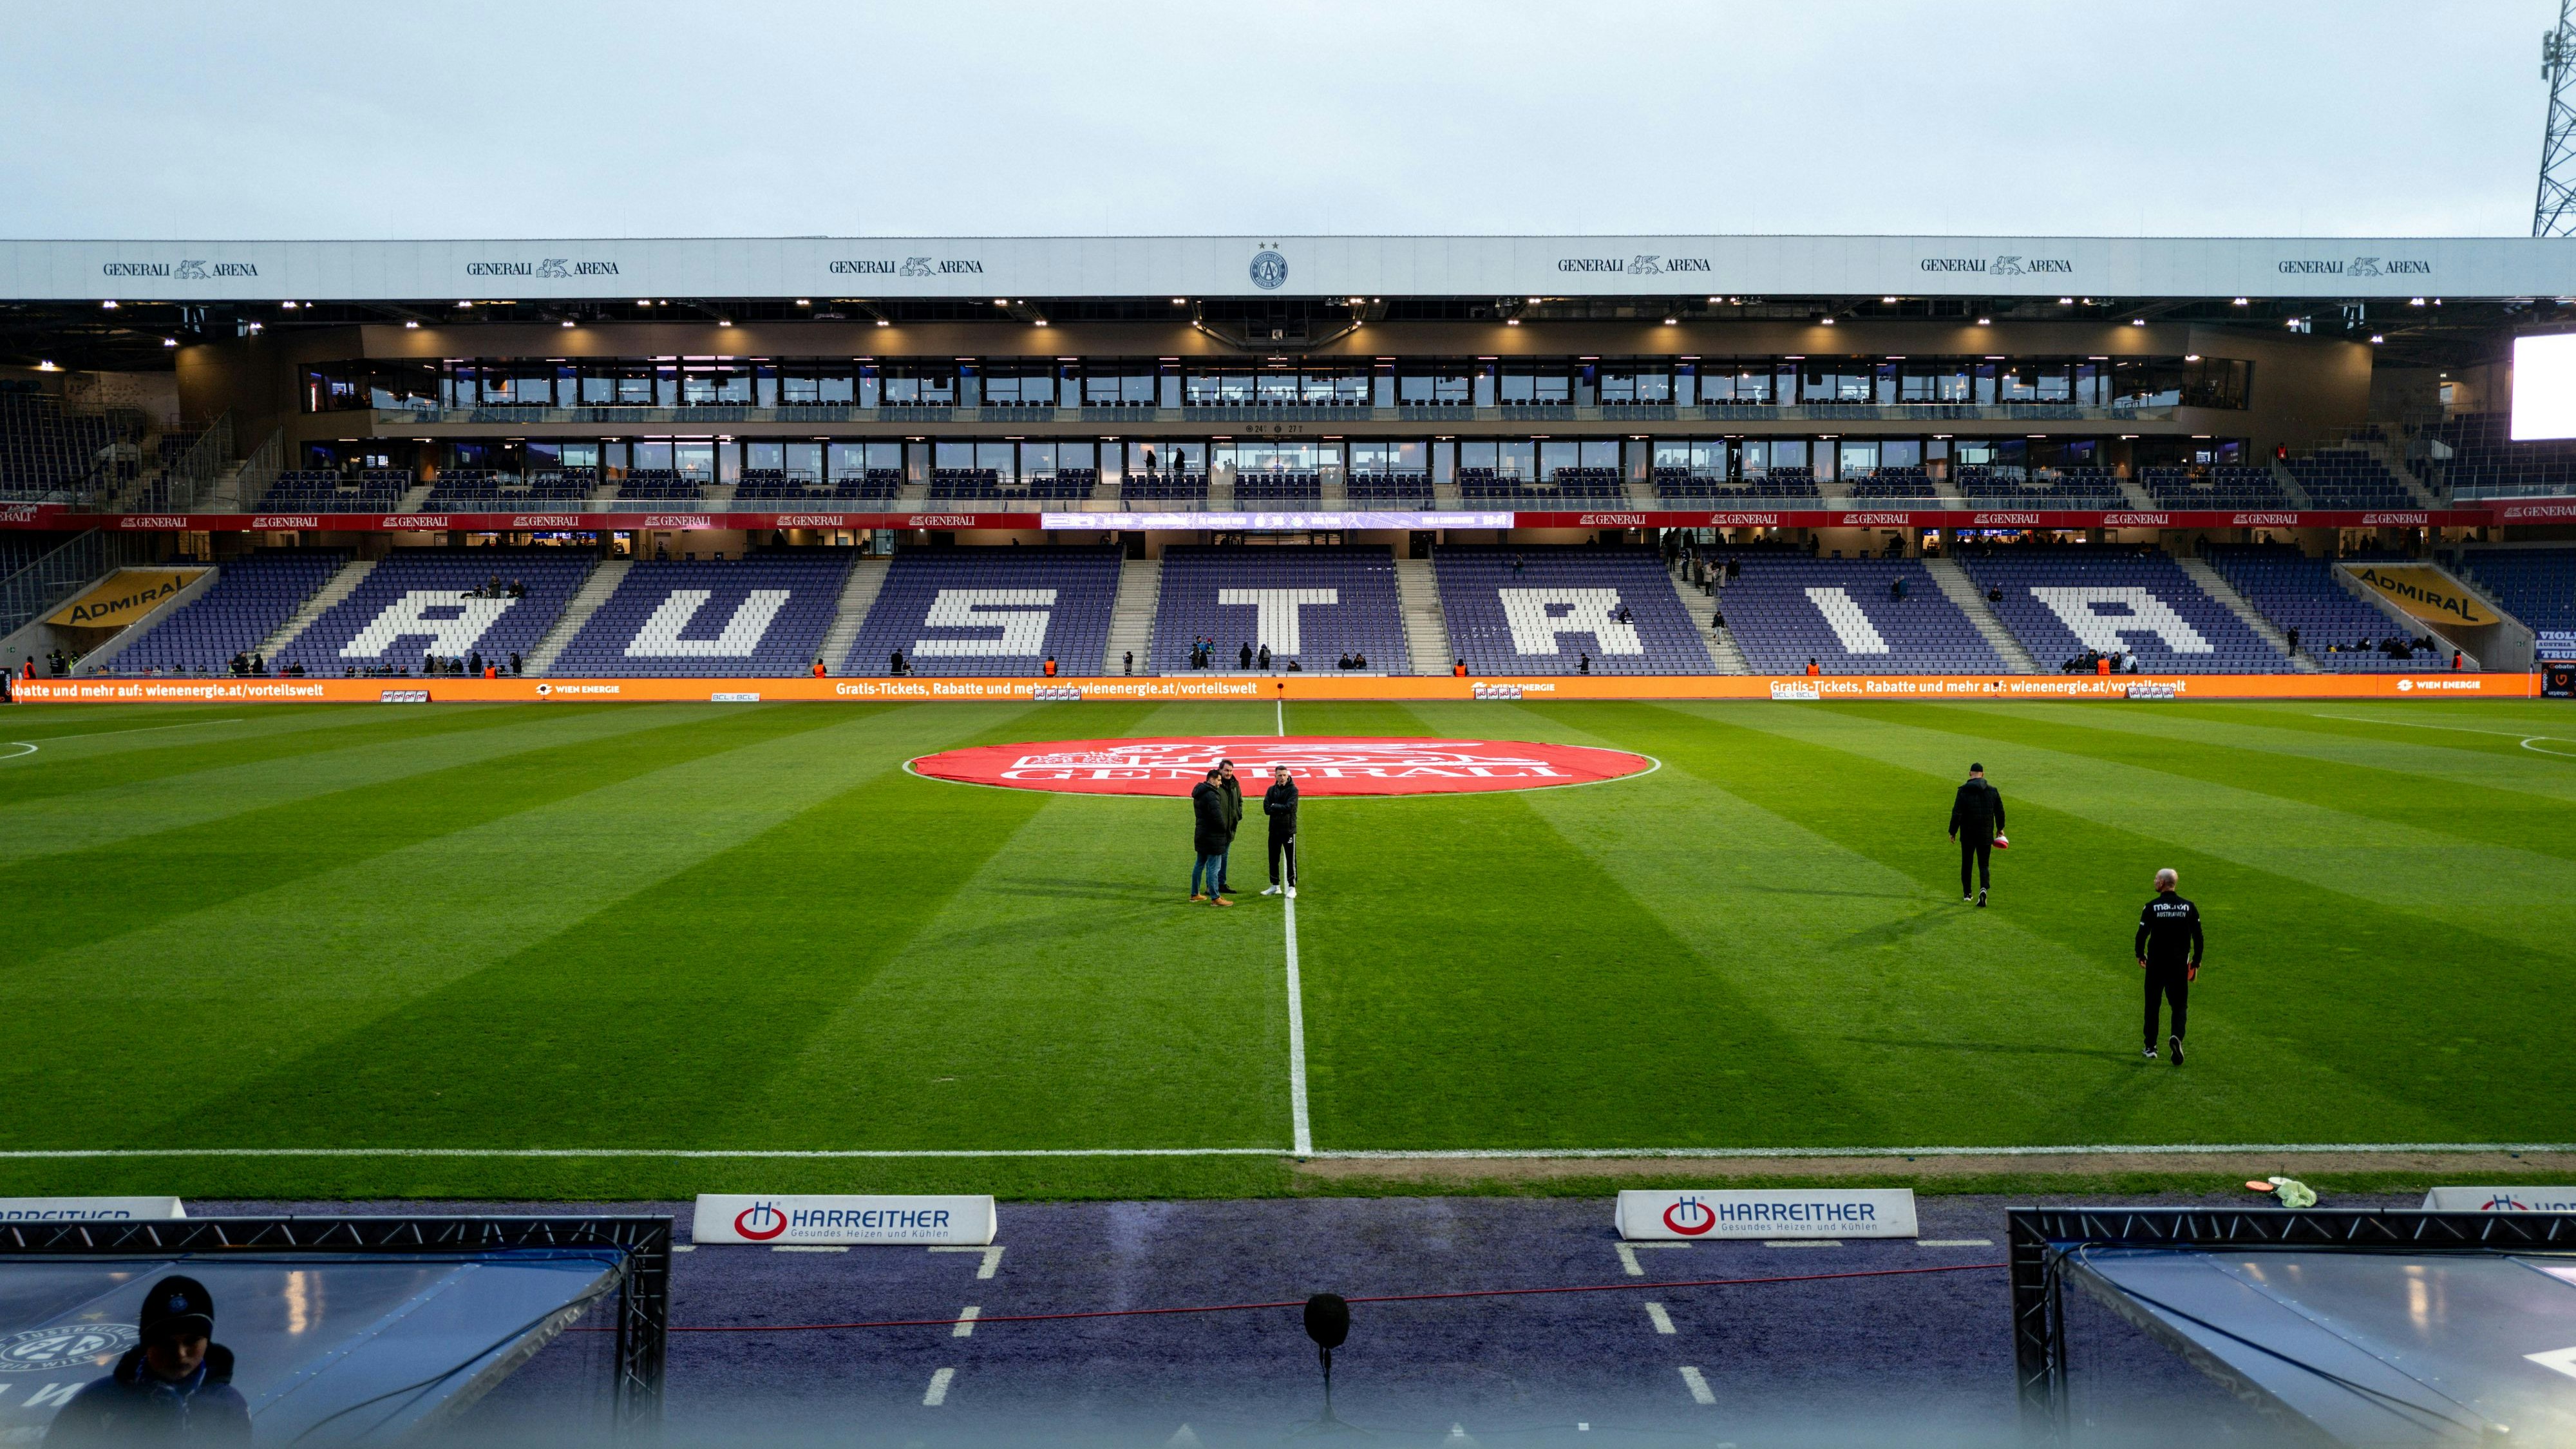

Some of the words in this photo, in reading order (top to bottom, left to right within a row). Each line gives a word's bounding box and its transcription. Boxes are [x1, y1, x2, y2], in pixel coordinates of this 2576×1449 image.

[104, 264, 169, 276] GENERALI
[213, 264, 257, 276] ARENA
[468, 263, 531, 274] GENERALI
[574, 263, 619, 274] ARENA
[830, 261, 895, 272] GENERALI
[938, 261, 983, 272] ARENA
[1558, 260, 1622, 271] GENERALI
[1666, 260, 1710, 271] ARENA
[1922, 260, 1985, 271] GENERALI
[2028, 260, 2072, 271] ARENA
[2279, 261, 2342, 272] GENERALI
[2385, 261, 2430, 273] ARENA
[137, 518, 186, 527] GENERALI
[269, 518, 317, 527] GENERALI
[399, 517, 448, 526] GENERALI
[529, 516, 578, 526] GENERALI
[661, 516, 711, 526] GENERALI
[793, 516, 842, 526] GENERALI
[925, 516, 974, 526] GENERALI
[1596, 515, 1645, 524] GENERALI
[1728, 515, 1777, 524] GENERALI
[1859, 514, 1908, 523] GENERALI
[1991, 514, 2039, 523] GENERALI
[2120, 514, 2168, 523] GENERALI
[2248, 514, 2297, 523] GENERALI
[2378, 514, 2427, 523] GENERALI
[70, 575, 191, 624] ADMIRAL
[2360, 569, 2478, 621] ADMIRAL
[2540, 632, 2576, 640] VIOL
[53, 685, 77, 696] und
[82, 685, 115, 696] mehr
[118, 685, 142, 696] auf:
[146, 685, 323, 699] wienenergie.at/vorteilswelt
[837, 683, 929, 696] Gratis-Tickets,
[934, 683, 983, 694] Rabatte
[987, 683, 1010, 694] und
[1079, 682, 1256, 697] wienenergie.at/vorteilswelt
[1770, 681, 1862, 694] Gratis-Tickets,
[1866, 681, 1915, 692] Rabatte
[1920, 681, 1943, 692] und
[1947, 681, 1980, 692] mehr
[1983, 680, 2007, 692] auf:
[1001, 768, 1573, 779] GENERALI
[1720, 1203, 1875, 1220] HARREITHER
[792, 1209, 949, 1227] HARREITHER
[1721, 1223, 1771, 1231] Gesundes
[1841, 1222, 1877, 1231] Kühlen
[791, 1229, 841, 1238] Gesundes
[847, 1229, 882, 1238] Heizen
[887, 1229, 907, 1238] und
[912, 1229, 949, 1238] Kühlen
[42, 1355, 97, 1368] WIEN
